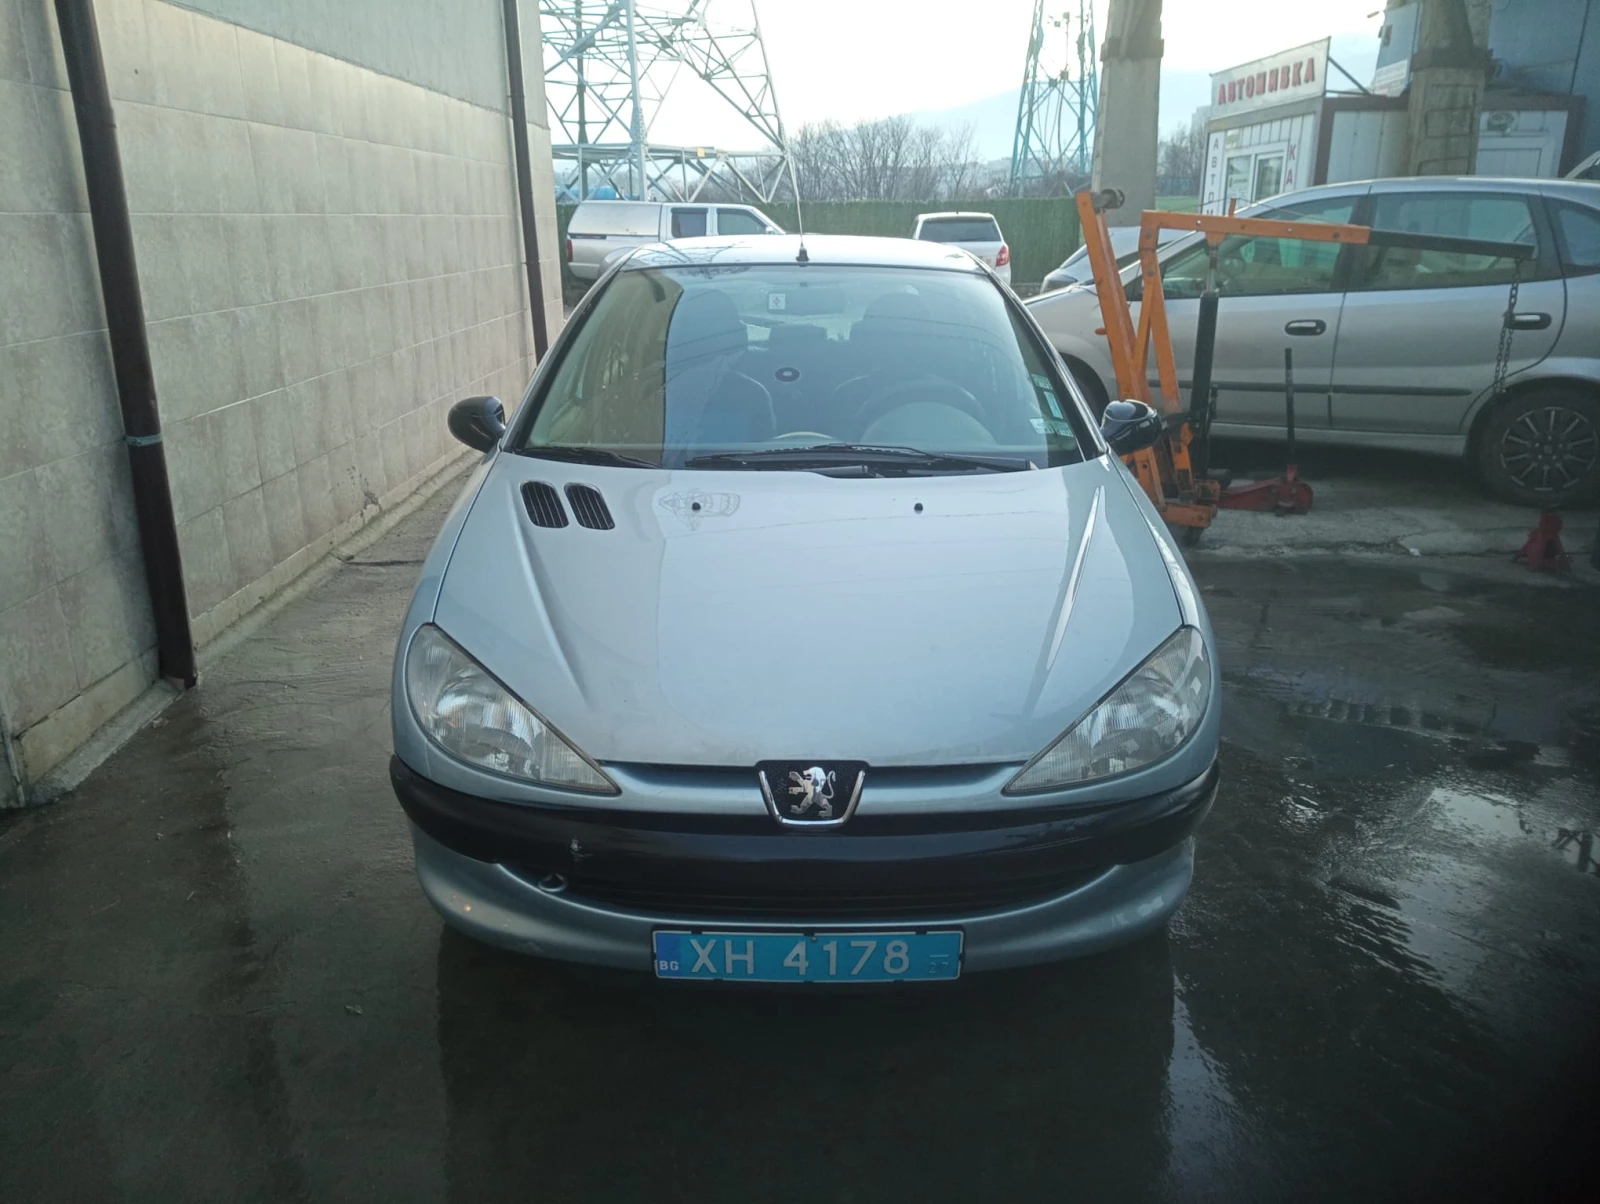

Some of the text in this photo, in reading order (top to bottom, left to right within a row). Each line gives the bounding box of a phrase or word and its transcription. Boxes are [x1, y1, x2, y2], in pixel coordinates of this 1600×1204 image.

[659, 961, 679, 971] BG
[689, 939, 910, 976] XH 4178
